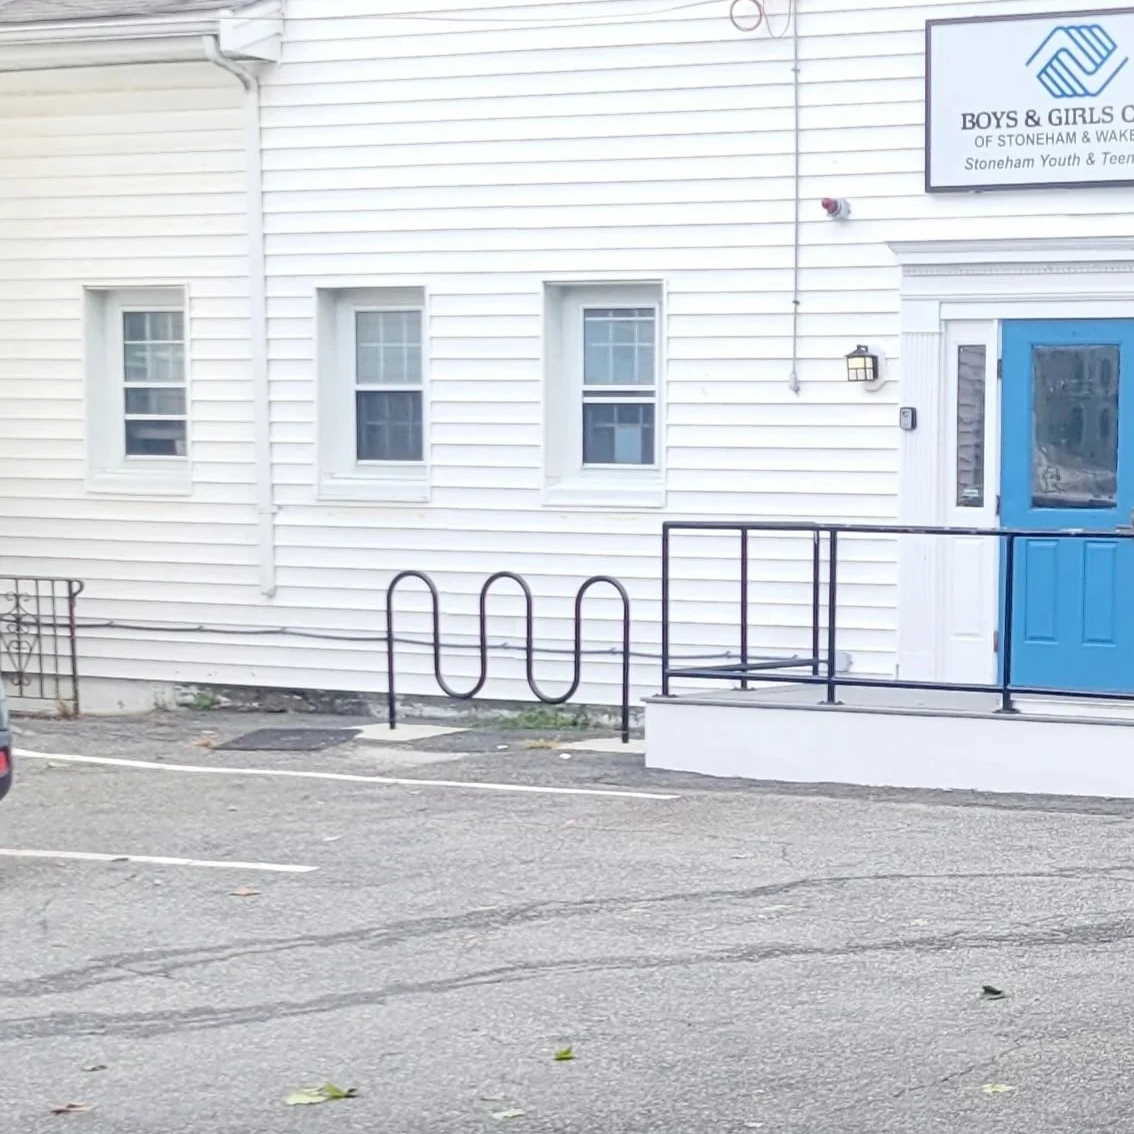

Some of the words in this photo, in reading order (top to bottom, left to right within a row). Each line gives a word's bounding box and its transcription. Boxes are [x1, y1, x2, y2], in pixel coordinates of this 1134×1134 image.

[960, 110, 1018, 131] BOYS
[1024, 109, 1042, 127] &
[1048, 106, 1114, 127] GIRLS
[975, 135, 993, 148] OF
[997, 131, 1077, 147] STONEHAM
[1081, 130, 1091, 142] &
[964, 156, 1035, 170] Stoneham
[1040, 154, 1080, 167] Youth
[1086, 153, 1095, 165] &
[1102, 152, 1134, 165] Teen
